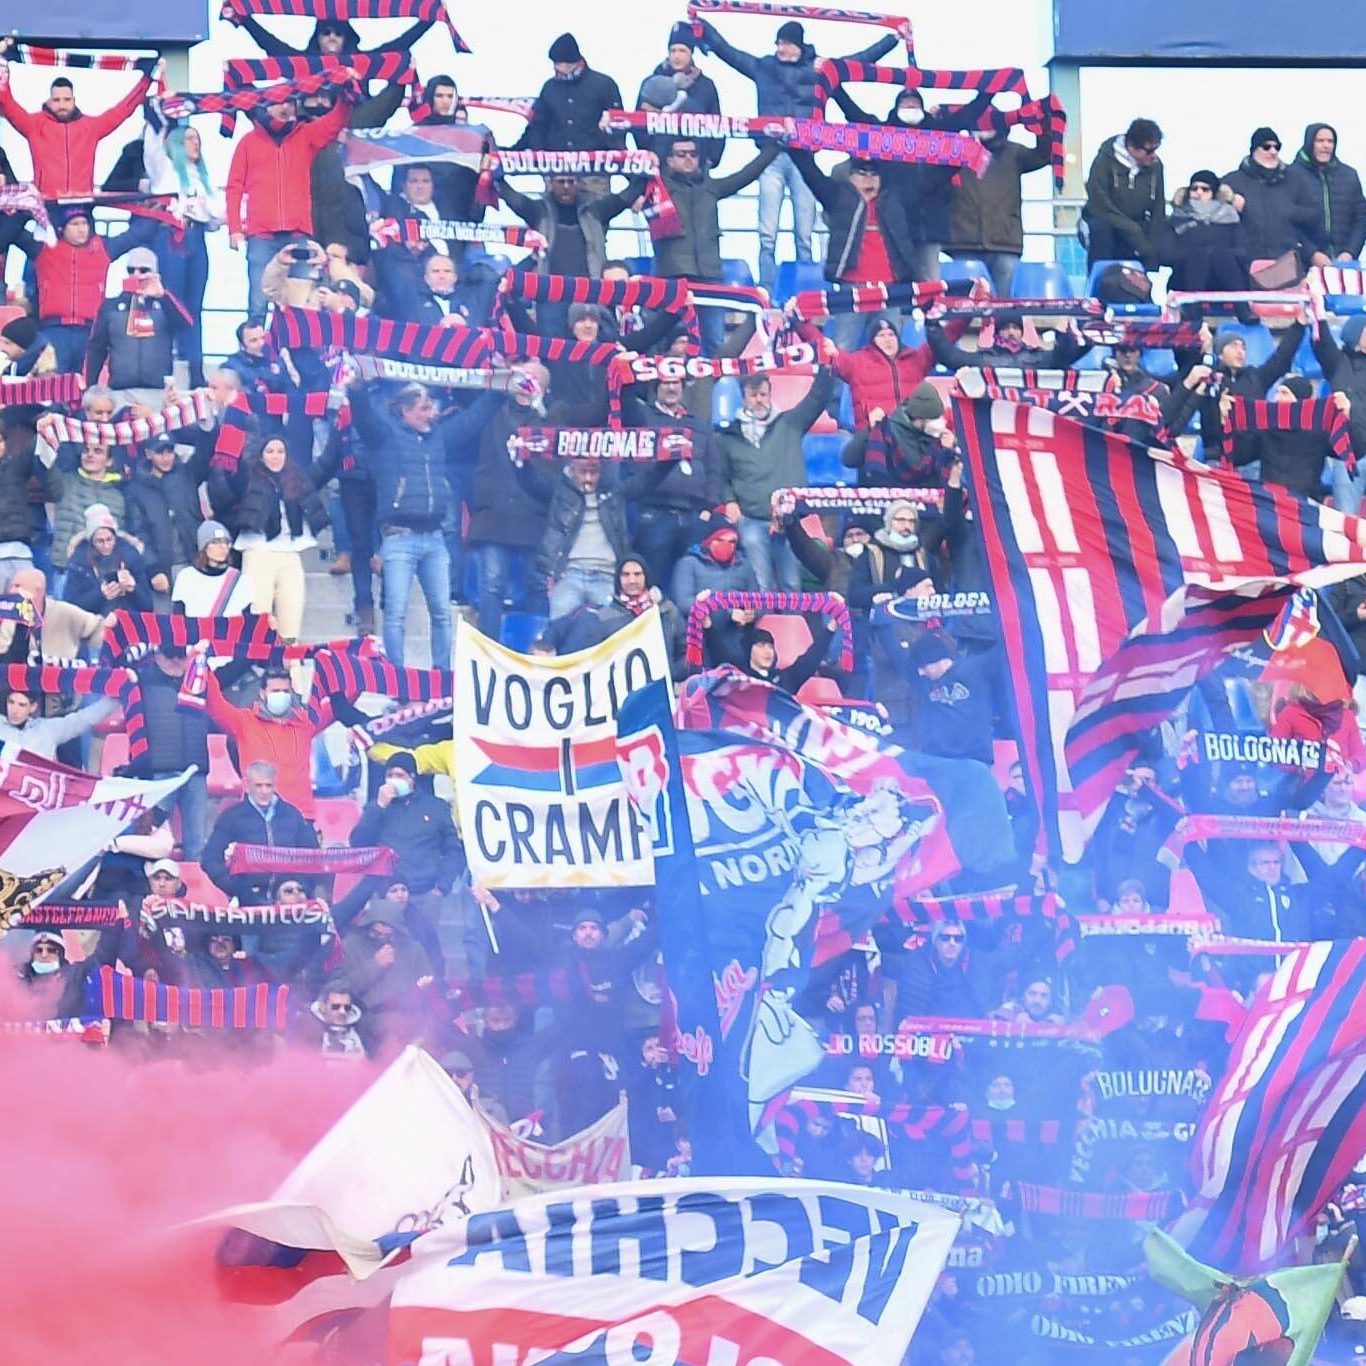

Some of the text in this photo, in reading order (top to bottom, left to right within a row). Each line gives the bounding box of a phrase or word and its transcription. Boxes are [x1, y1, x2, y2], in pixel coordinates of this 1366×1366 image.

[646, 112, 726, 138] BOLOGNA
[503, 153, 618, 174] BOLOGNA FC
[558, 431, 638, 457] BOLOGNA
[470, 648, 655, 731] VOGLIO
[1206, 733, 1299, 766] BOLOGNA
[561, 738, 575, 797] I
[152, 902, 277, 924] SIAM FATTI
[860, 1034, 952, 1061] ROSSOBLU
[1099, 1071, 1194, 1099] BOLOGNA
[978, 1273, 1040, 1296] ODIO
